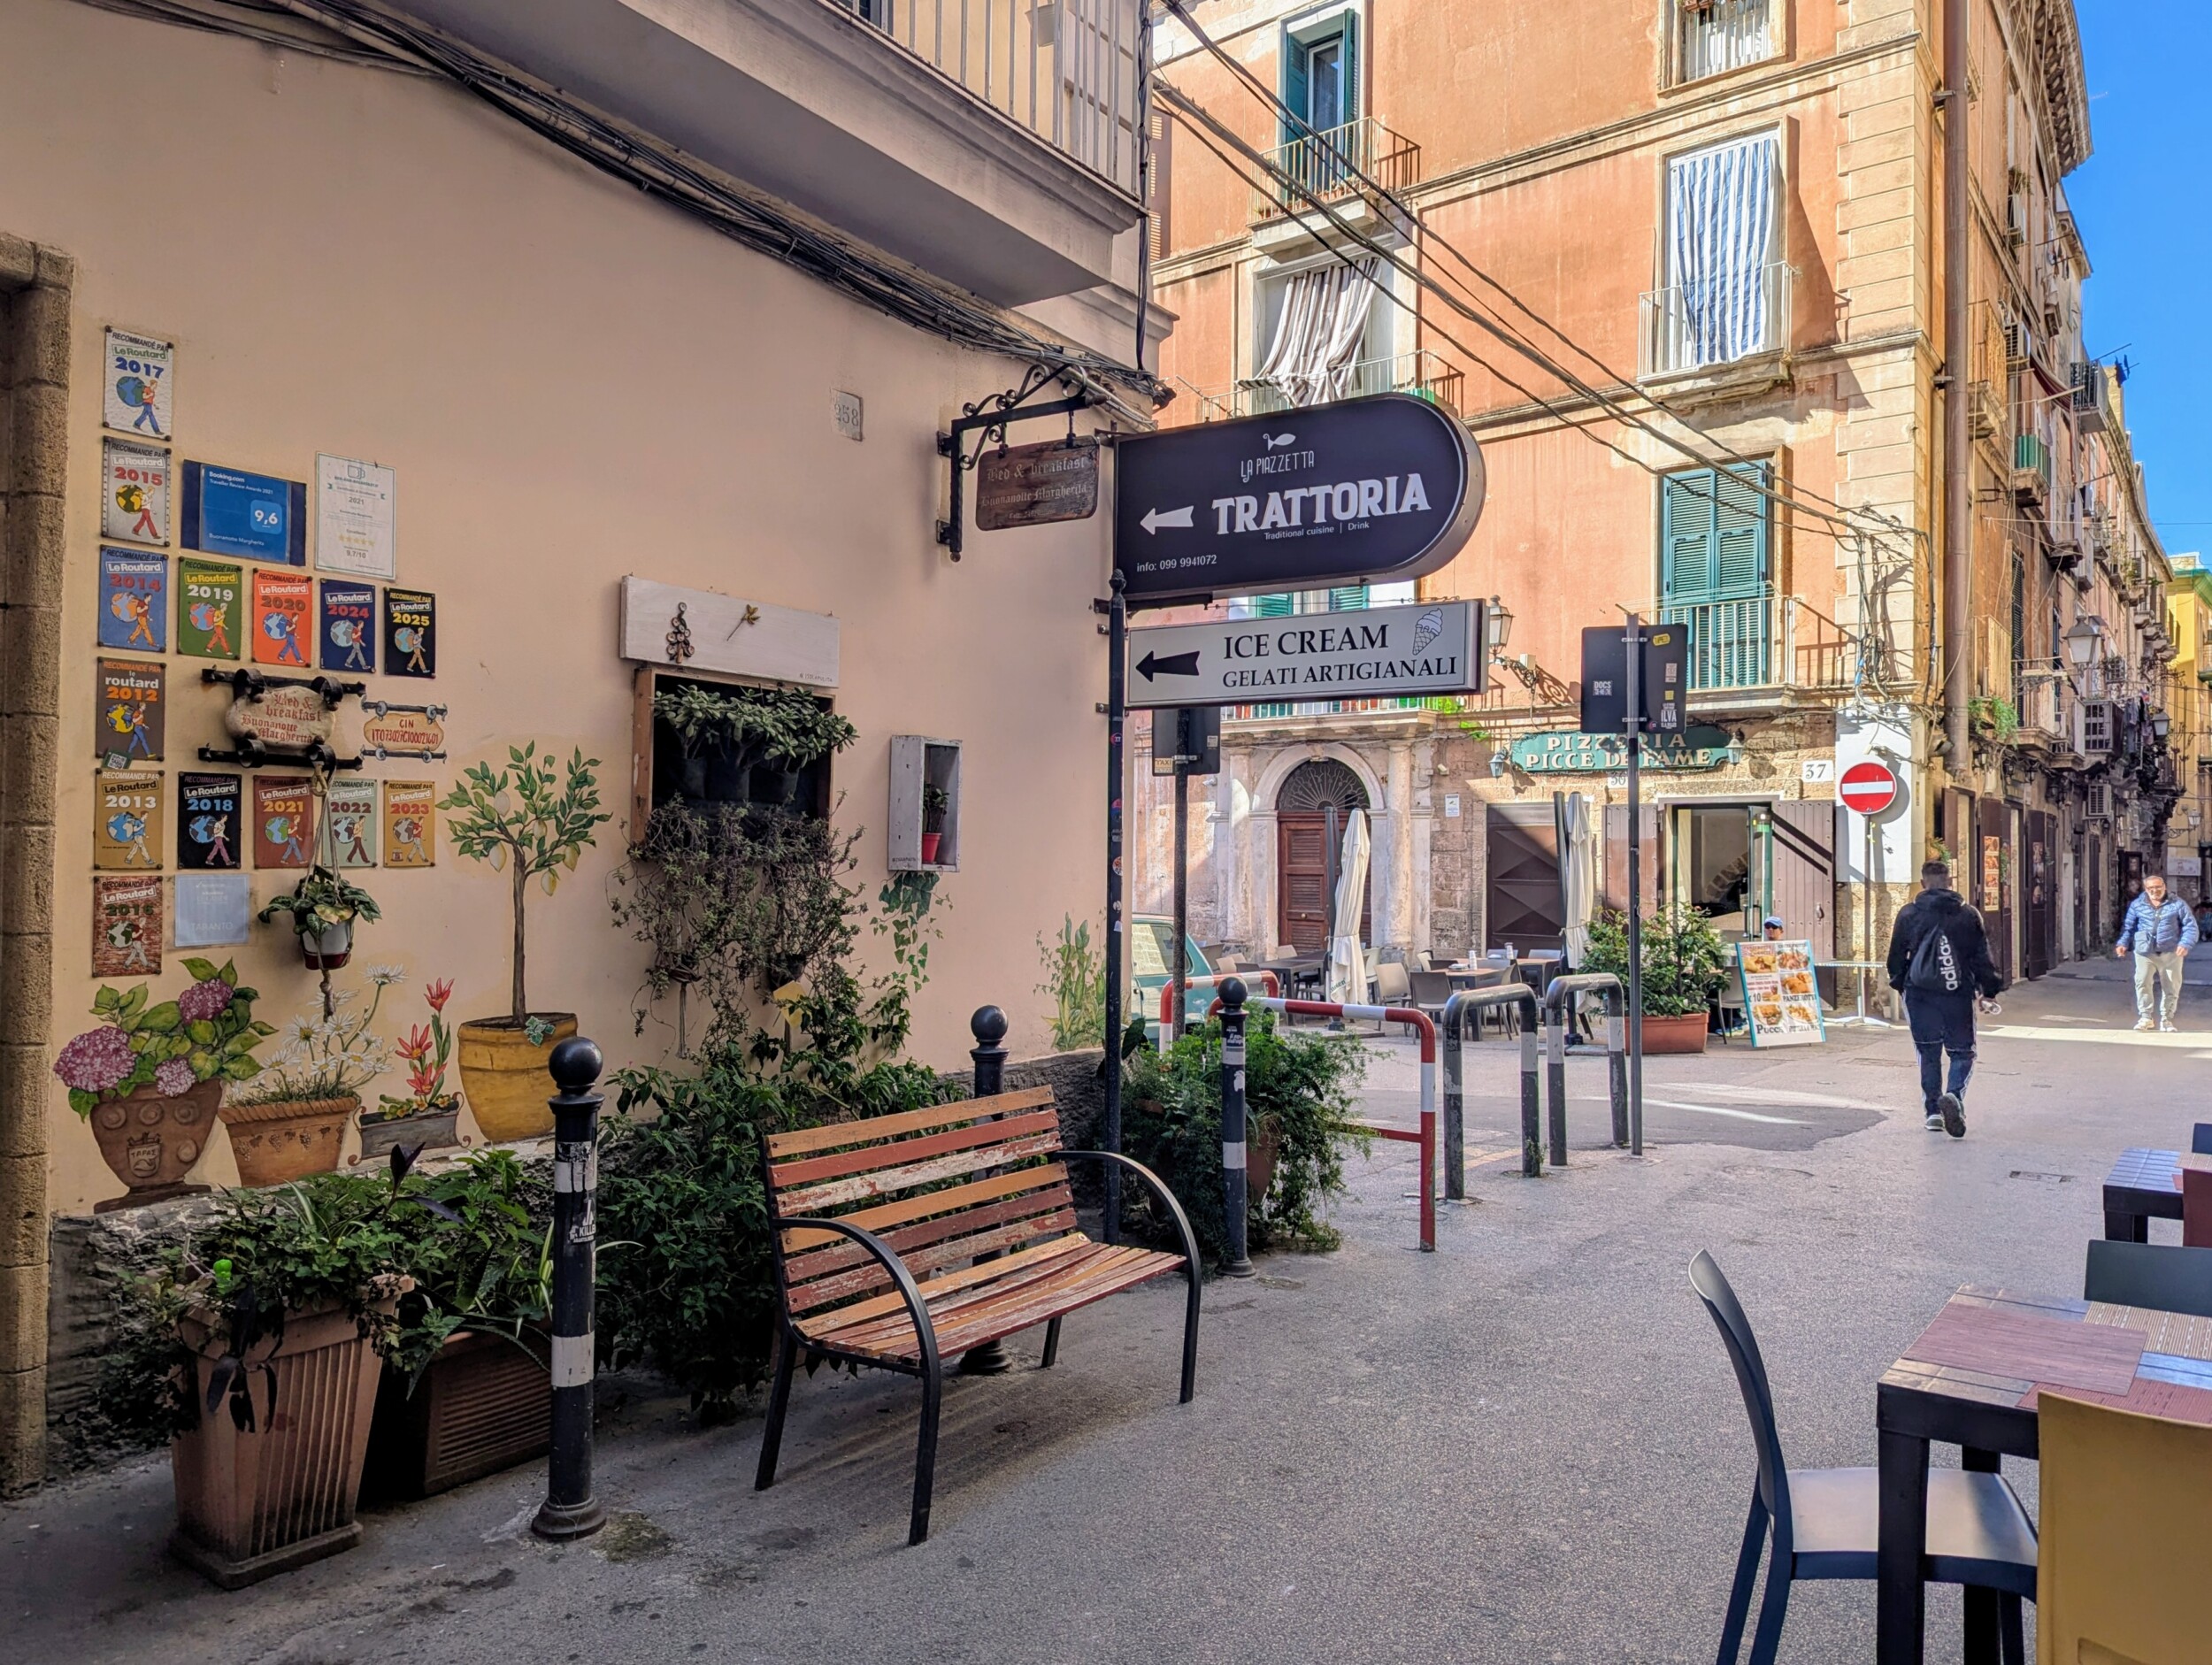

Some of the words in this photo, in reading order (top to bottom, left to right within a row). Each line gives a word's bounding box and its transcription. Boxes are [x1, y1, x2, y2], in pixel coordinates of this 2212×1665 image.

[111, 332, 156, 349] RECOMMANDÉ
[113, 346, 127, 356] Le
[127, 348, 166, 359] Routard
[114, 357, 165, 379] 2017
[125, 457, 164, 467] Routard
[1013, 464, 1025, 479] &
[1030, 456, 1086, 476] breakfast
[1240, 458, 1254, 483] LA
[1256, 450, 1315, 477] PIAZZETTA
[114, 466, 163, 487] 2015
[209, 471, 245, 482] Booking.com
[348, 496, 365, 505] 2021
[1211, 472, 1432, 535] TRATTORIA
[254, 510, 278, 525] 9,6
[1263, 527, 1305, 541] Traditional
[1306, 526, 1335, 536] cuisine
[1348, 521, 1370, 531] Drink
[120, 562, 161, 572] Routard
[1136, 560, 1157, 573] info:
[1159, 556, 1178, 571] 099
[1179, 554, 1217, 568] 9941072
[110, 573, 161, 592] 2014
[198, 573, 236, 583] Routard
[188, 585, 234, 602] 2019
[272, 585, 306, 594] Routard
[260, 595, 306, 611] 2020
[337, 593, 371, 602] Routard
[327, 603, 370, 618] 2024
[392, 612, 430, 626] 2025
[1224, 633, 1270, 660] ICE
[1277, 624, 1389, 655] CREAM
[1223, 667, 1297, 688] GELATI
[1303, 656, 1457, 684] ARTIGIANALI
[105, 677, 159, 688] routard
[1594, 680, 1611, 689] DOCS
[106, 686, 157, 702] 2012
[302, 696, 312, 710] &
[266, 705, 322, 722] breakfast
[1661, 709, 1677, 722] ILVA
[241, 714, 298, 732] Buonanotte
[399, 719, 414, 728] CIN
[1525, 752, 1595, 769] PICCE
[1643, 748, 1711, 768] FAME
[1805, 763, 1826, 779] 37
[117, 780, 157, 791] Routard
[186, 788, 198, 797] Le
[198, 784, 235, 796] Routard
[261, 791, 273, 800] Le
[272, 786, 308, 798] Routard
[340, 788, 372, 799] Routard
[401, 790, 430, 801] Routard
[104, 795, 157, 809] 2013
[187, 798, 234, 811] 2018
[263, 801, 303, 812] 2021
[331, 802, 372, 813] 2022
[389, 803, 429, 815] 2023
[116, 887, 154, 901] Routard
[105, 903, 154, 916] 2016
[190, 921, 234, 932] TARANTO
[1939, 935, 1958, 991] adidas
